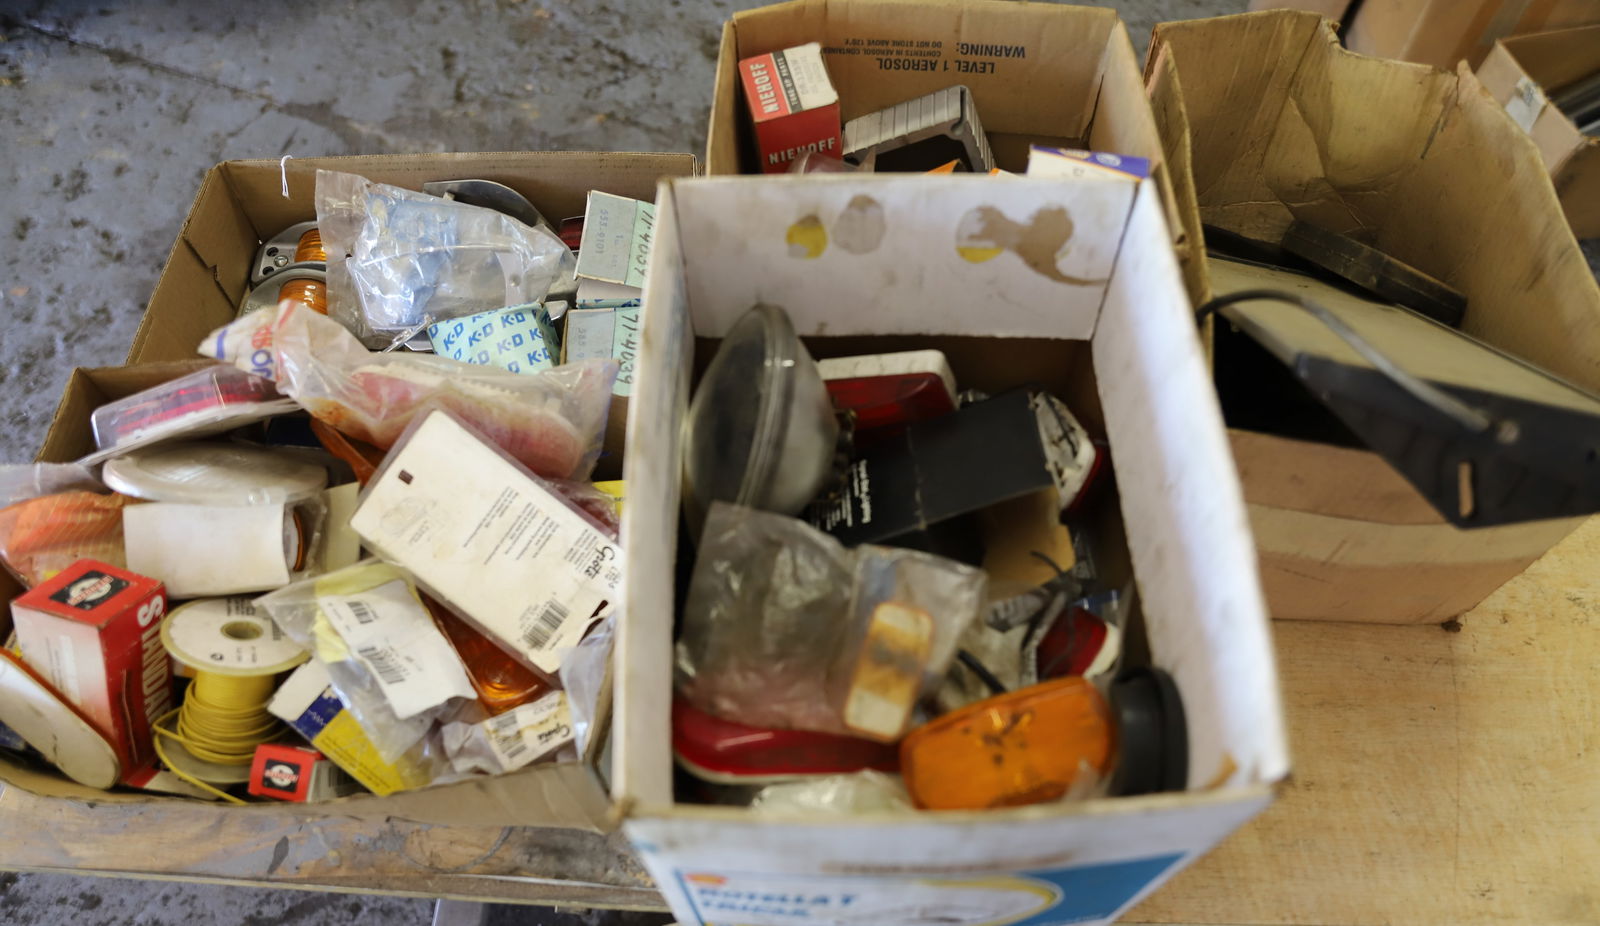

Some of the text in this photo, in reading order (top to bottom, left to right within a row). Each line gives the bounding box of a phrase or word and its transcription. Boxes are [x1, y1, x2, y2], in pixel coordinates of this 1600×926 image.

[956, 42, 1026, 58] WARNING:
[876, 57, 995, 74] LEVEL 1 AEROSOL
[749, 63, 780, 114] NIEHOFF
